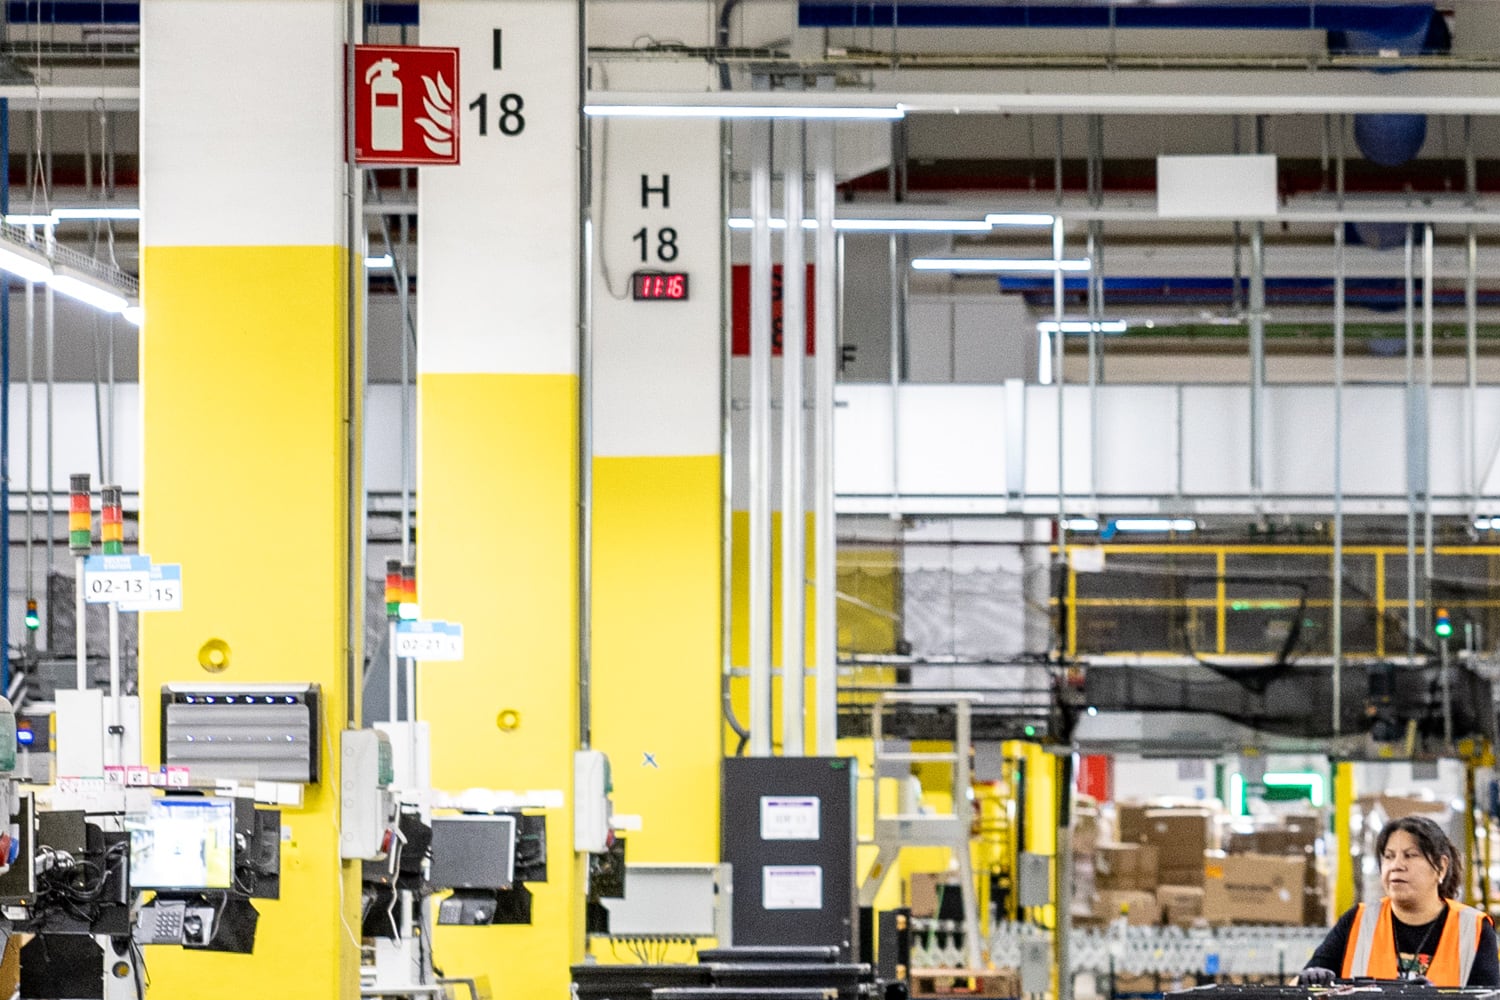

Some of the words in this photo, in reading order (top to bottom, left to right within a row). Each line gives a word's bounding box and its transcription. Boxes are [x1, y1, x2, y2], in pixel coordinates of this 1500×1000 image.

[493, 29, 502, 70] I
[469, 93, 526, 136] 18
[641, 175, 670, 208] H
[632, 227, 679, 262] 18
[642, 275, 684, 299] 11:16
[92, 579, 143, 594] 02-13
